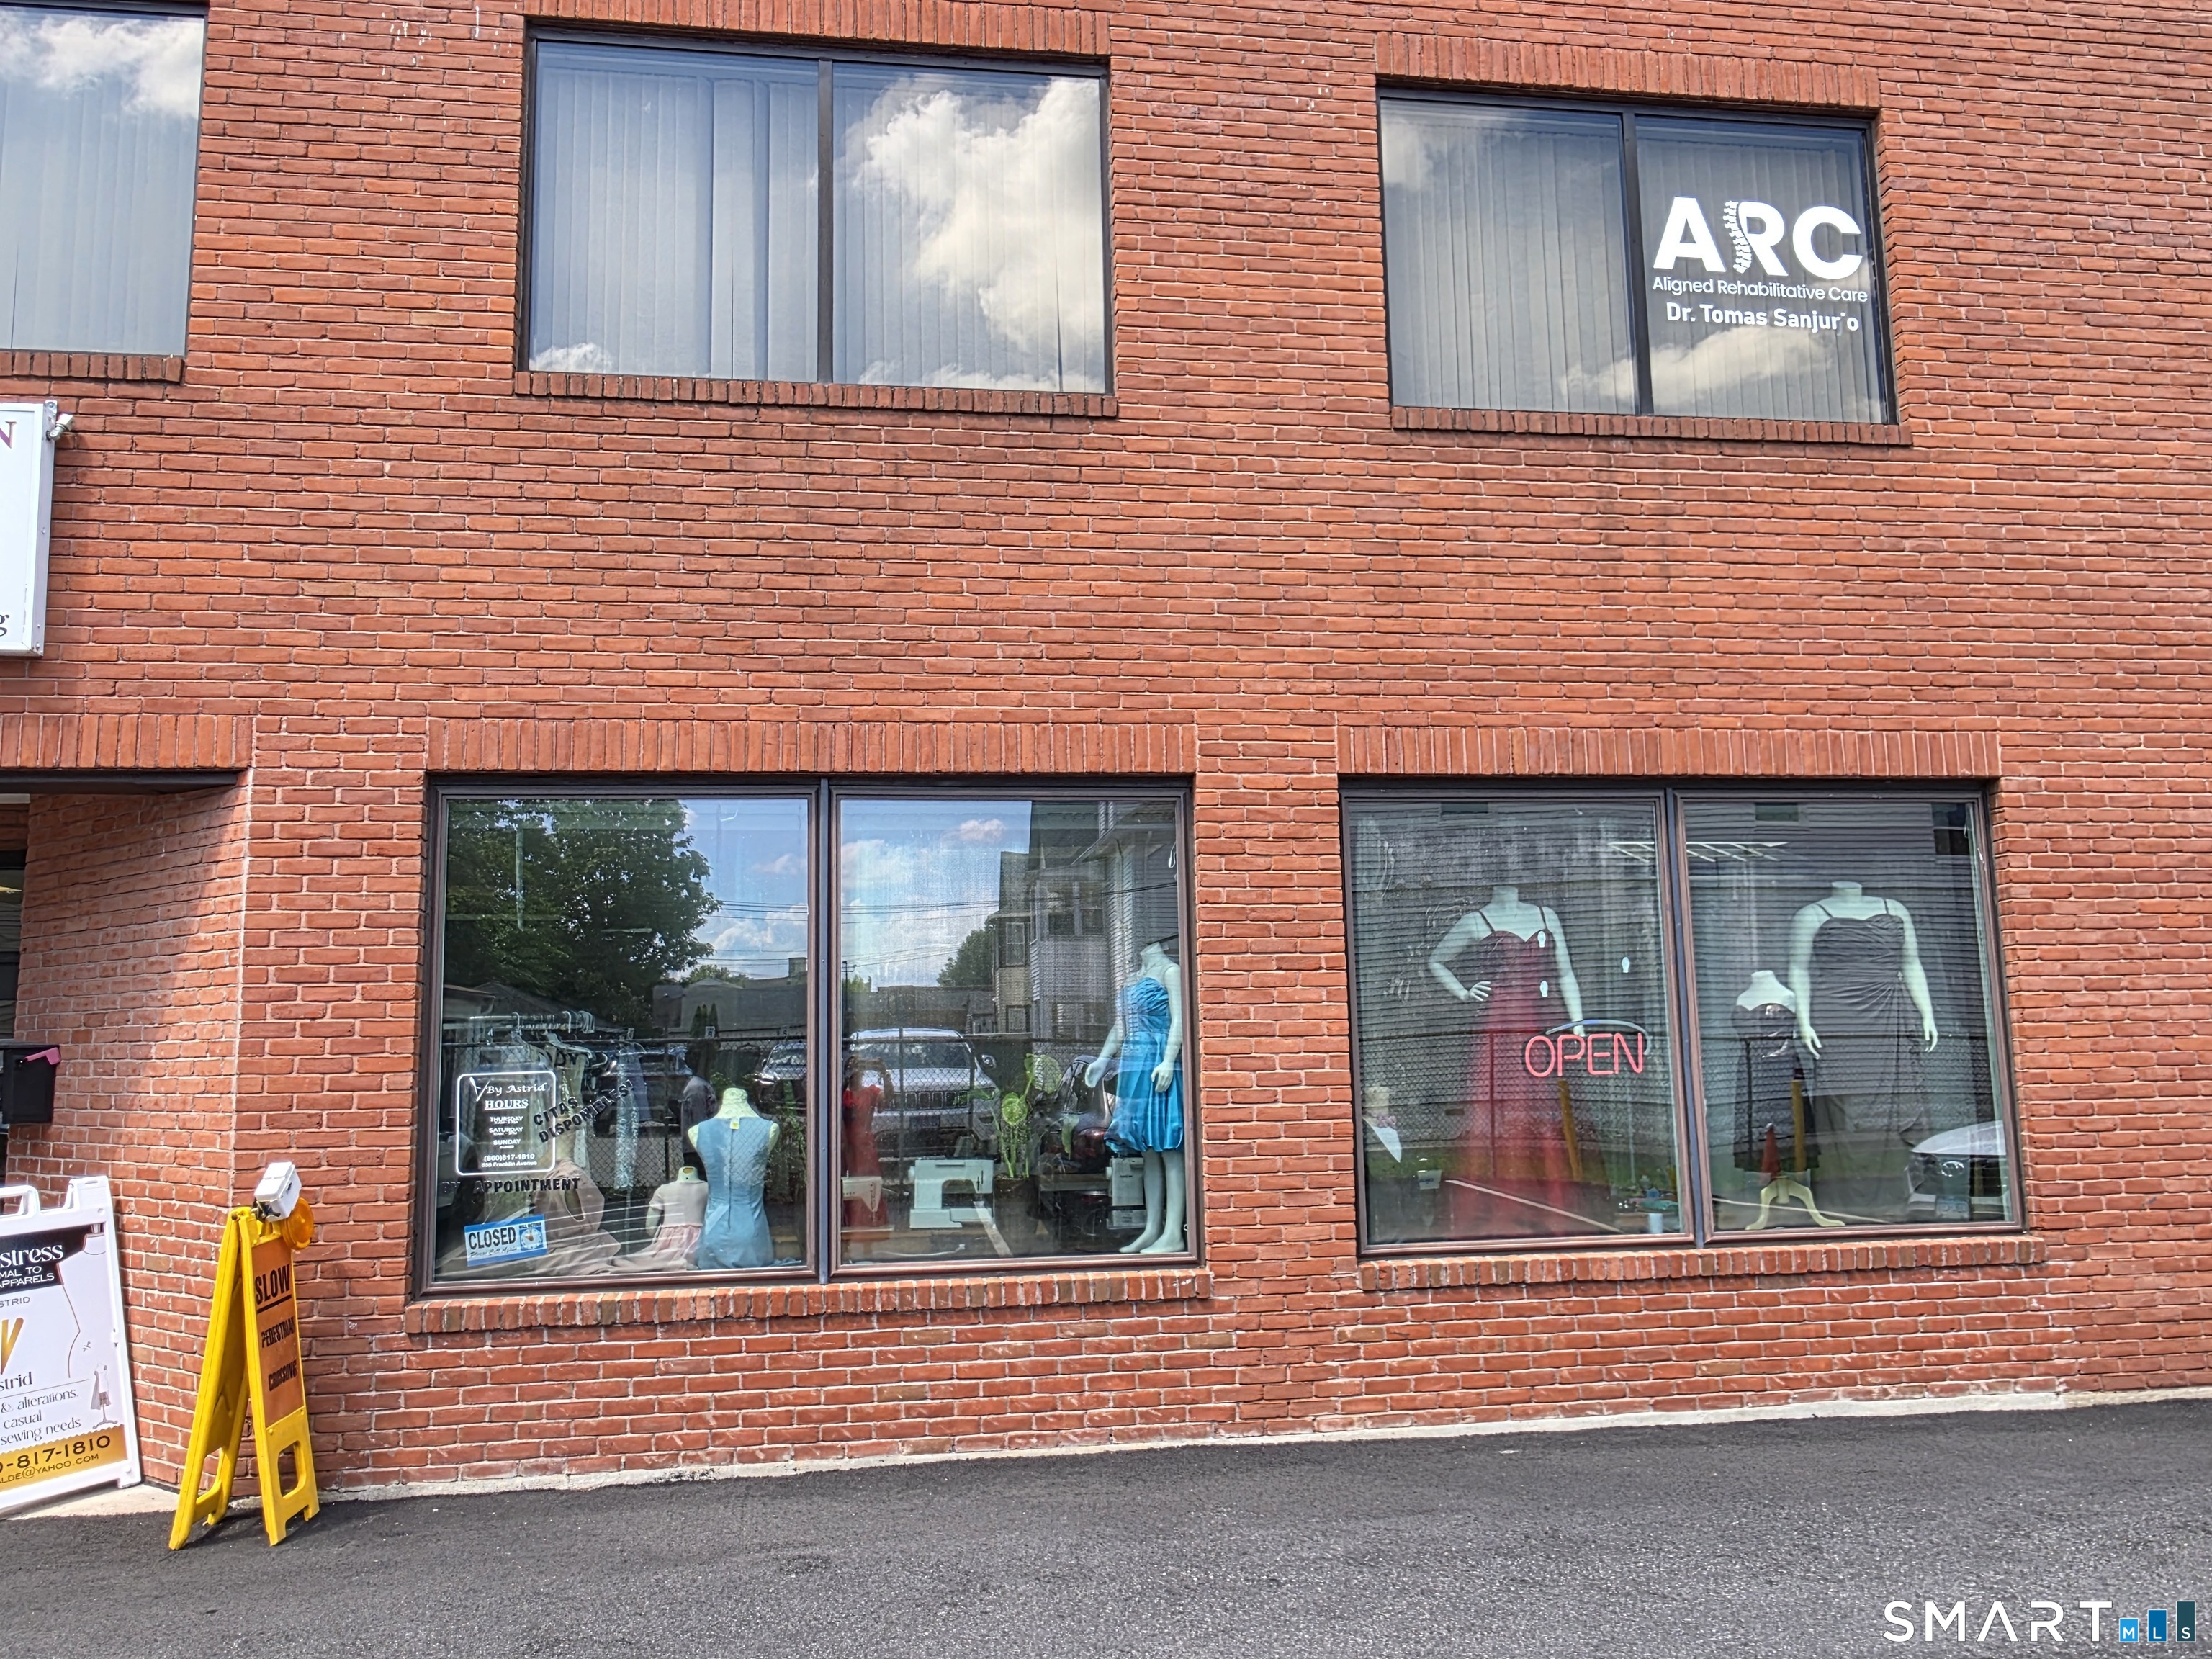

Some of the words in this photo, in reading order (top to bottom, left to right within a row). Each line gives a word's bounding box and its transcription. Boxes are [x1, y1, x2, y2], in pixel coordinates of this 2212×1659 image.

[1653, 196, 1863, 280] ARC
[1653, 276, 1714, 297] Aligned
[1717, 279, 1826, 300] Rehabilitative
[1828, 287, 1869, 303] Care
[1666, 302, 1696, 323] Dr.
[1699, 304, 1768, 326] Tomas
[1524, 1032, 1644, 1078] OPEN
[485, 1086, 503, 1096] By
[505, 1082, 548, 1094] Astrid
[485, 1099, 529, 1110] HOURS
[533, 1096, 579, 1126] CITAS
[472, 1176, 580, 1194] APPOINTMENT
[468, 1226, 516, 1250] CLOSED
[0, 1244, 64, 1268] stress
[25, 1266, 42, 1274] TO
[255, 1264, 291, 1305] SLOW
[261, 1316, 295, 1349] PEDESTRIAN
[1, 1427, 42, 1446] sewing
[45, 1417, 82, 1435] needs
[4, 1409, 42, 1429] casual
[0, 1435, 111, 1473] -817-1810
[0, 1453, 99, 1484] LDE@YAHOO.COM
